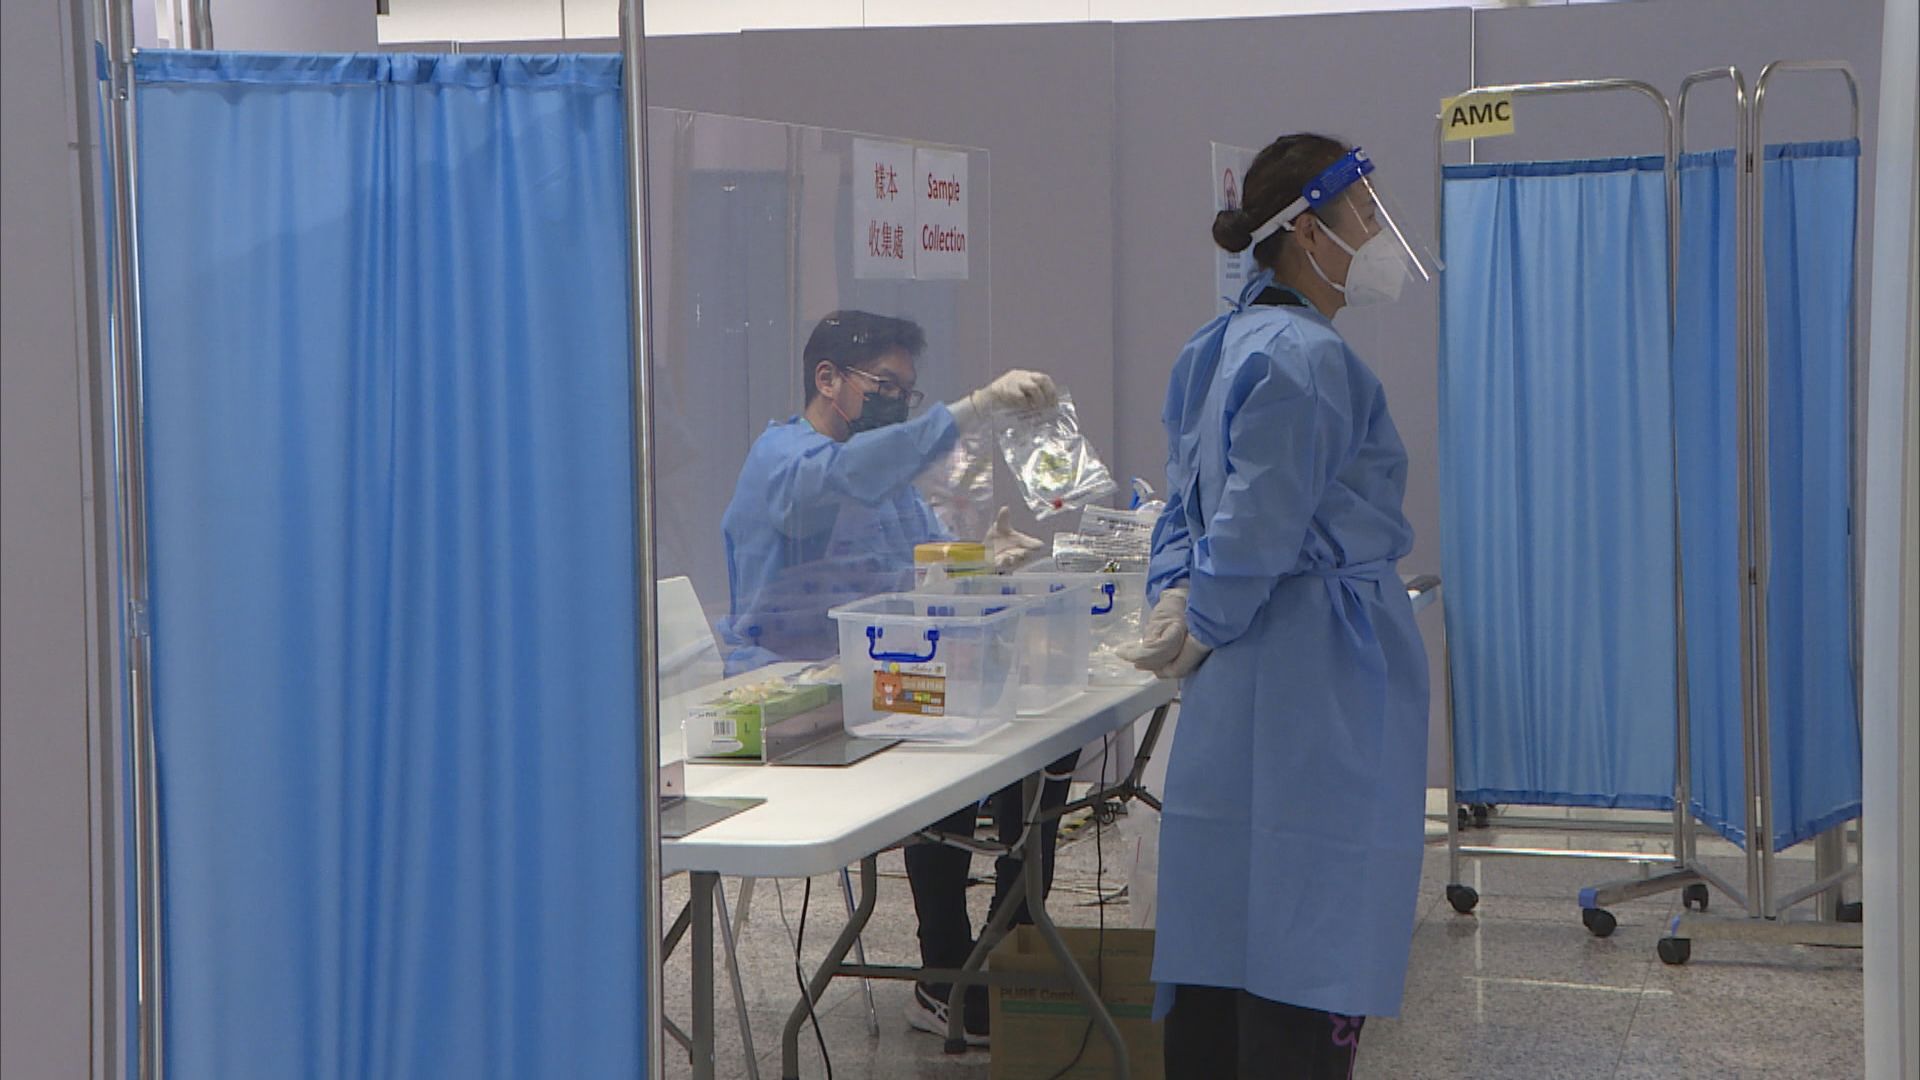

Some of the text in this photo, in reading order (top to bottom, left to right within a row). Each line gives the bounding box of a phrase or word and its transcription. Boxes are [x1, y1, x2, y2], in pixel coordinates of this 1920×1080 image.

[1451, 101, 1510, 127] AMC
[874, 161, 898, 202] 樣本
[927, 171, 960, 207] Sample
[868, 219, 904, 259] 收集處
[922, 223, 966, 252] Collection
